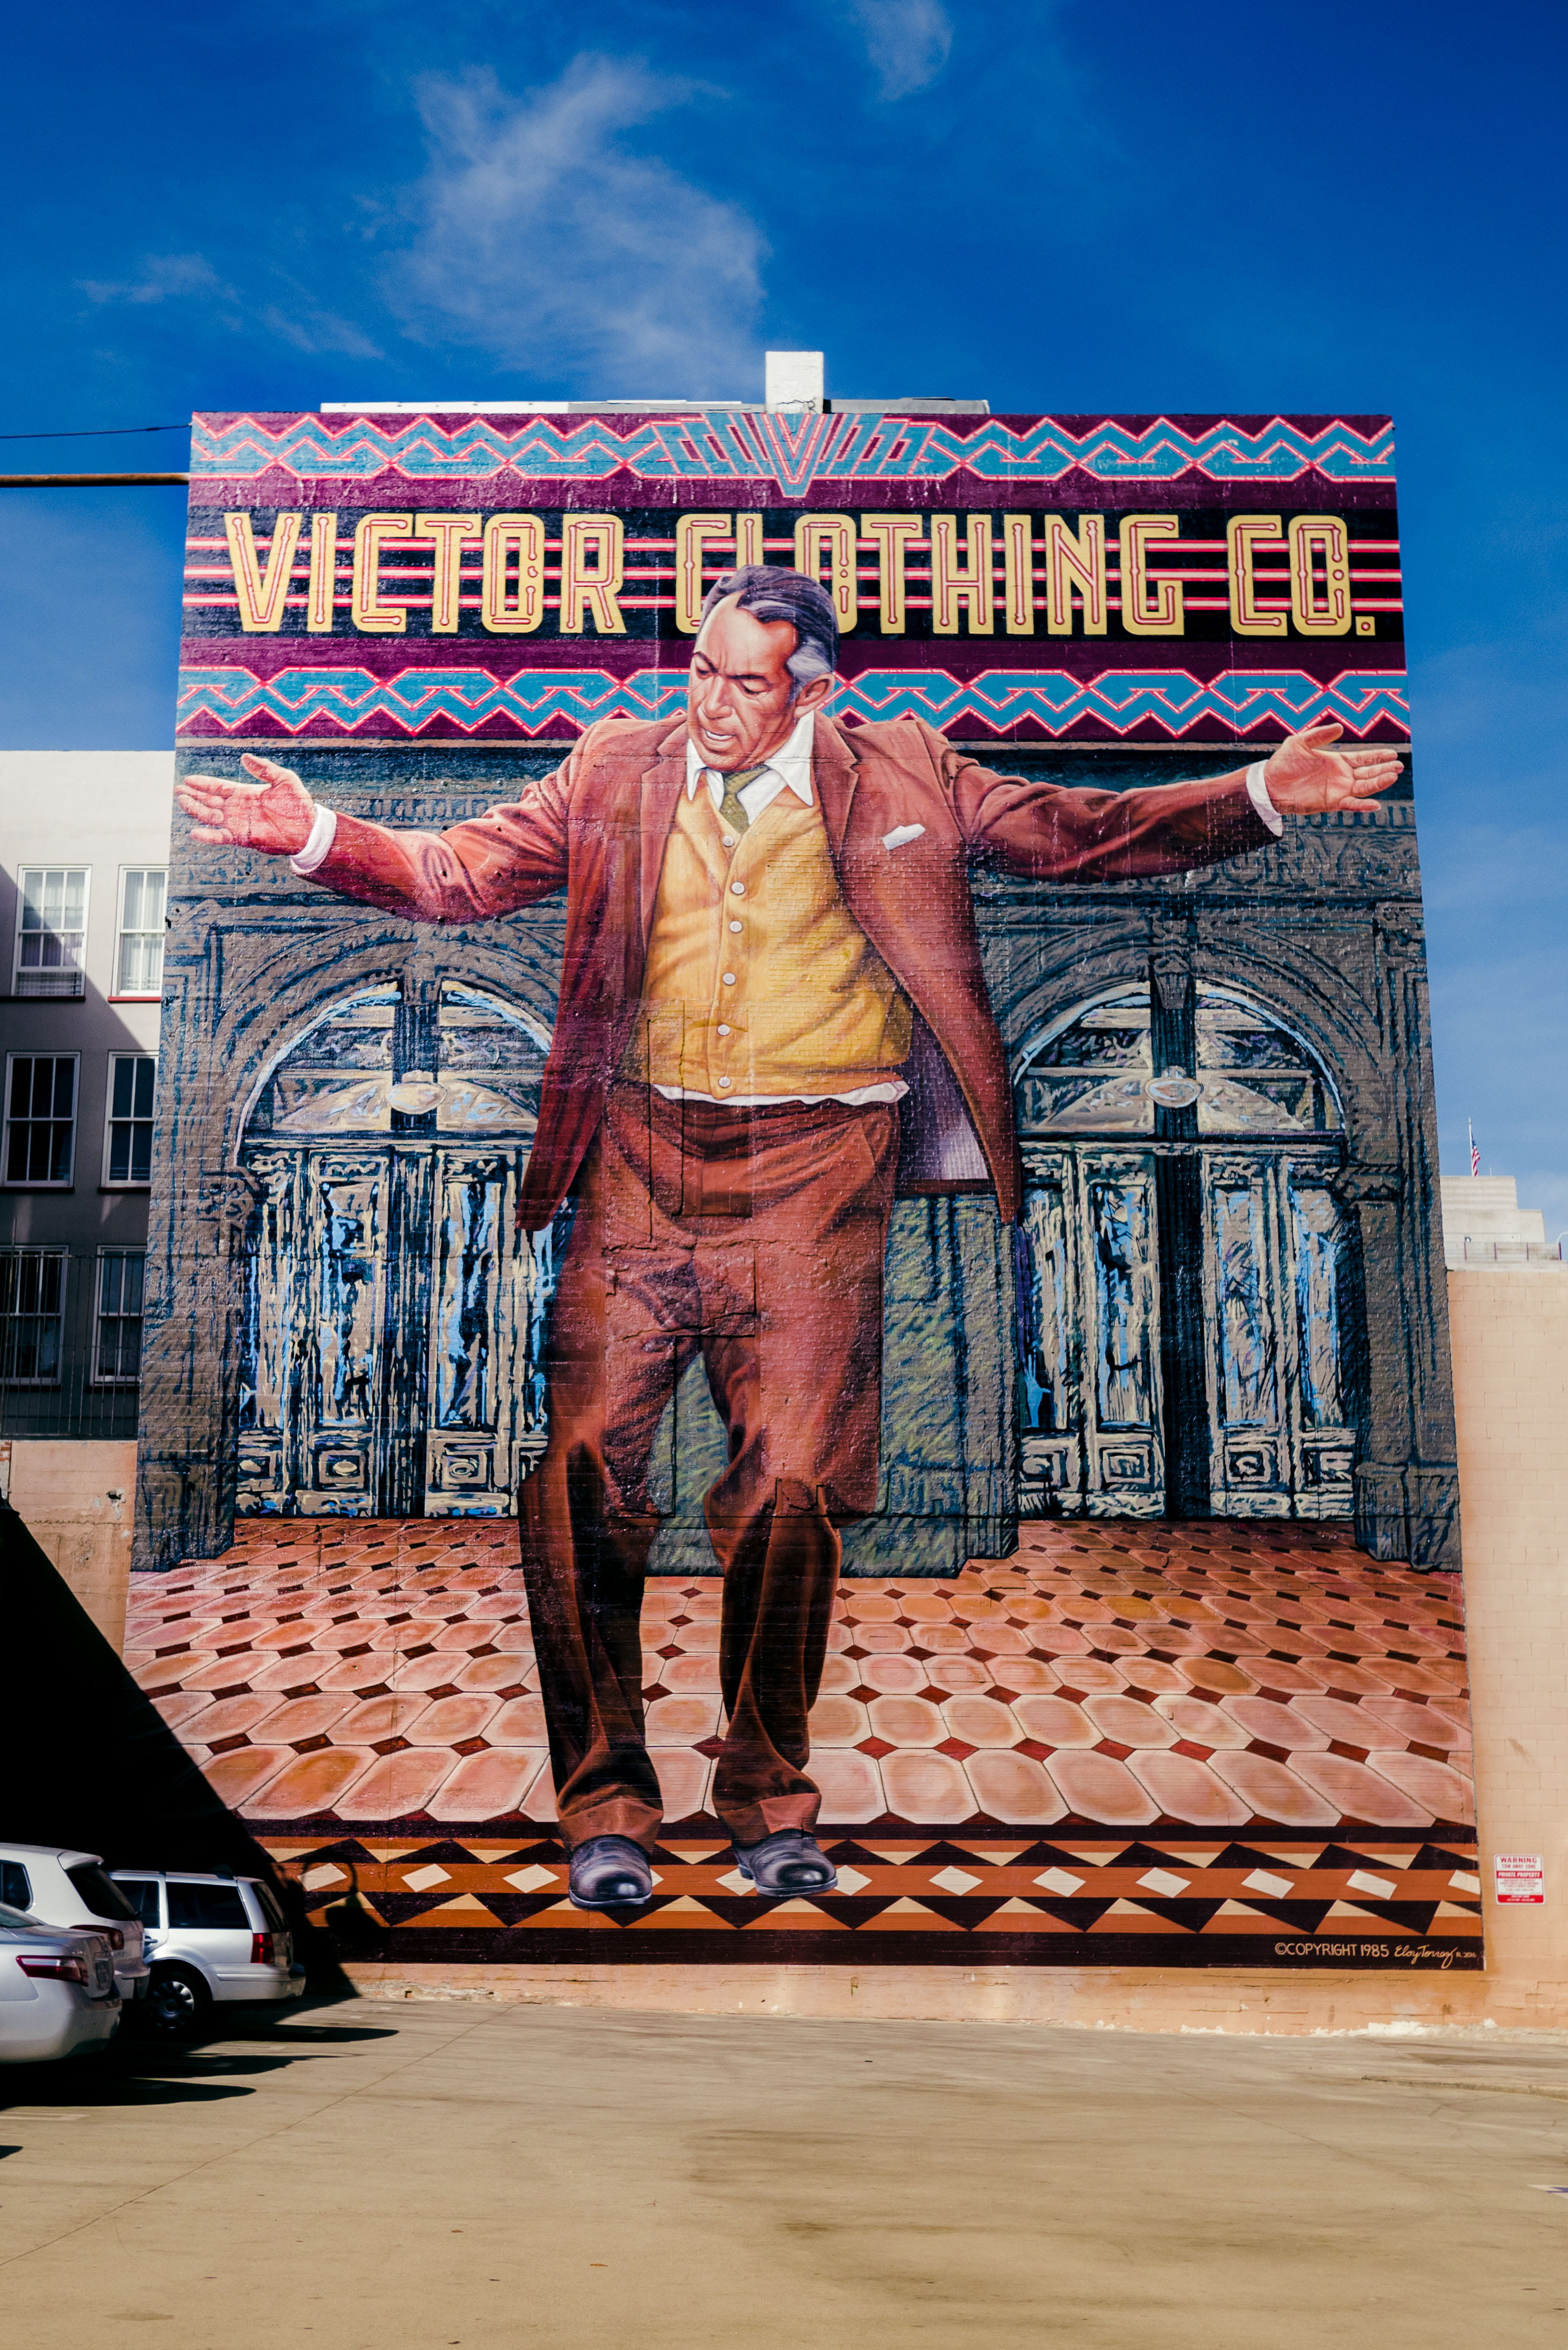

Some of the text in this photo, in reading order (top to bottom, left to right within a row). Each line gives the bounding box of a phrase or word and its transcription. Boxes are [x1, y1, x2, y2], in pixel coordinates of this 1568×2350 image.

[224, 512, 626, 634] VICTOR
[1227, 515, 1376, 636] CO.
[1360, 1944, 1389, 1957] 1985
